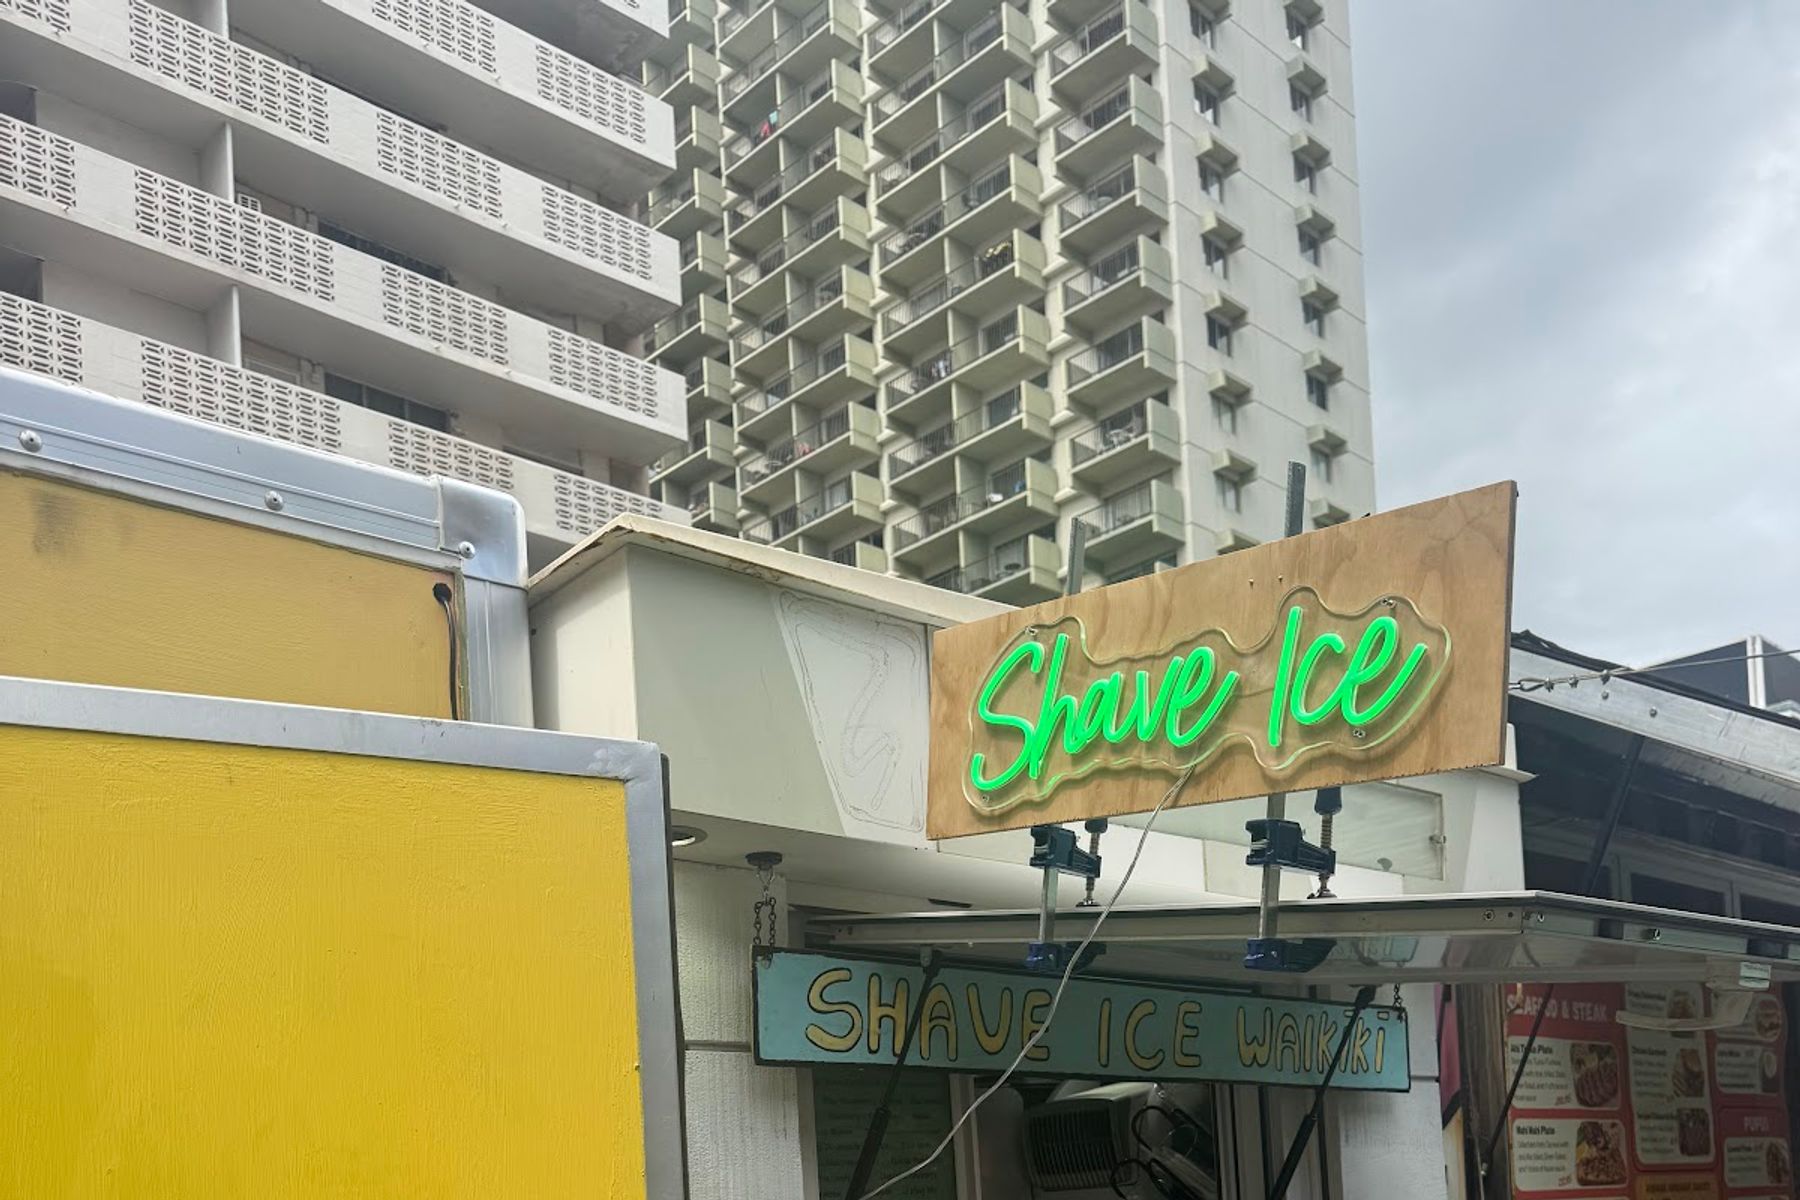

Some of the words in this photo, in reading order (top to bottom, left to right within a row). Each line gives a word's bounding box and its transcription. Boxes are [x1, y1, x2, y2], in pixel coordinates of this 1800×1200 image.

[971, 632, 1240, 792] Shave
[1267, 606, 1428, 748] Ice
[805, 967, 1053, 1062] SHAVE
[1097, 997, 1203, 1071] ICE
[1571, 1001, 1609, 1022] STEAK
